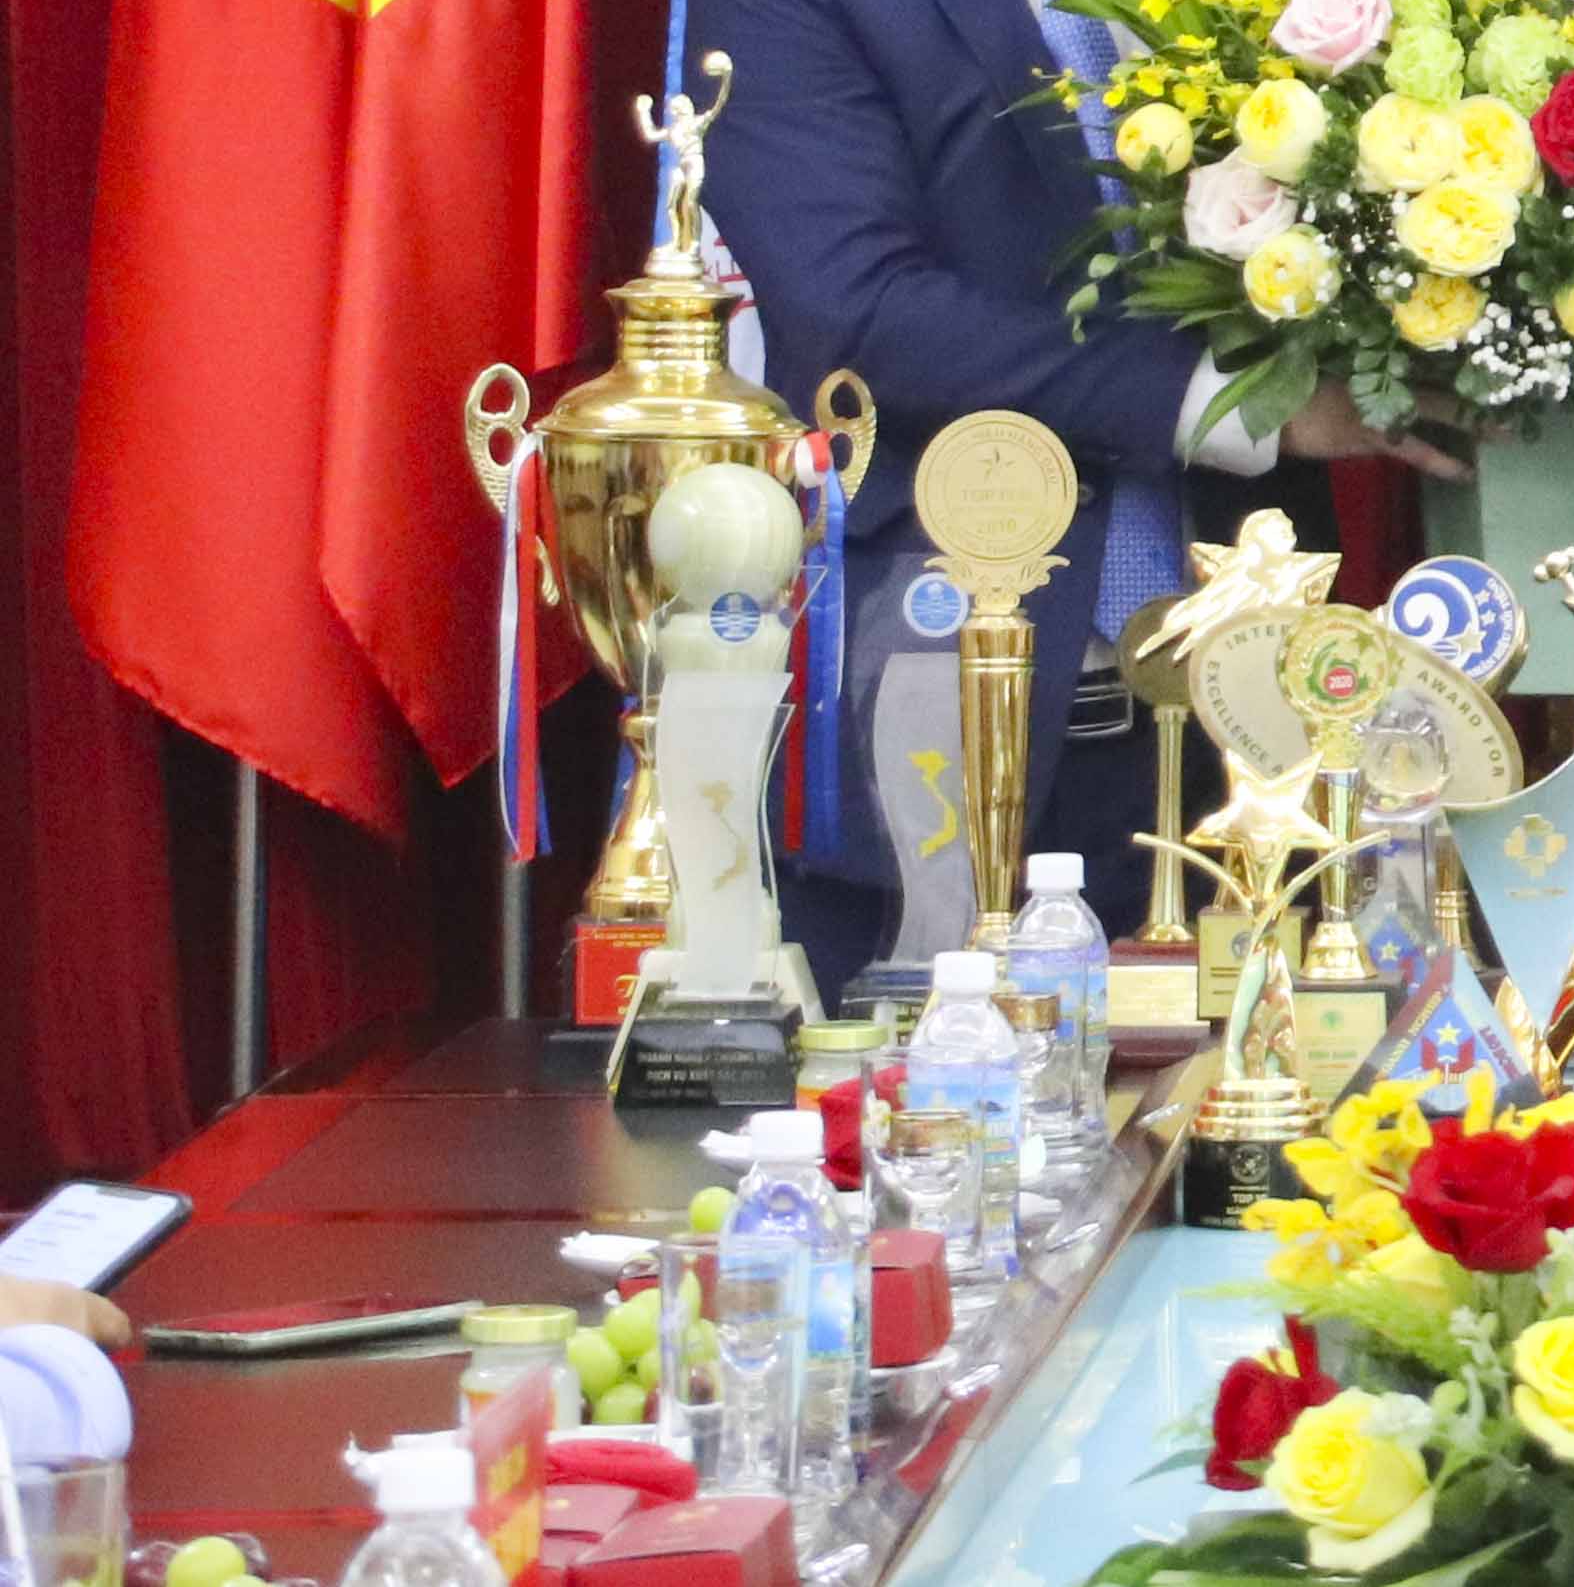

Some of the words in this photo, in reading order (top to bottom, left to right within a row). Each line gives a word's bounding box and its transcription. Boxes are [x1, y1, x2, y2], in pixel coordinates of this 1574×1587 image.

[1206, 660, 1271, 764] EXCELLENCE
[1416, 669, 1483, 729] AWARD
[1482, 735, 1507, 779] FOR
